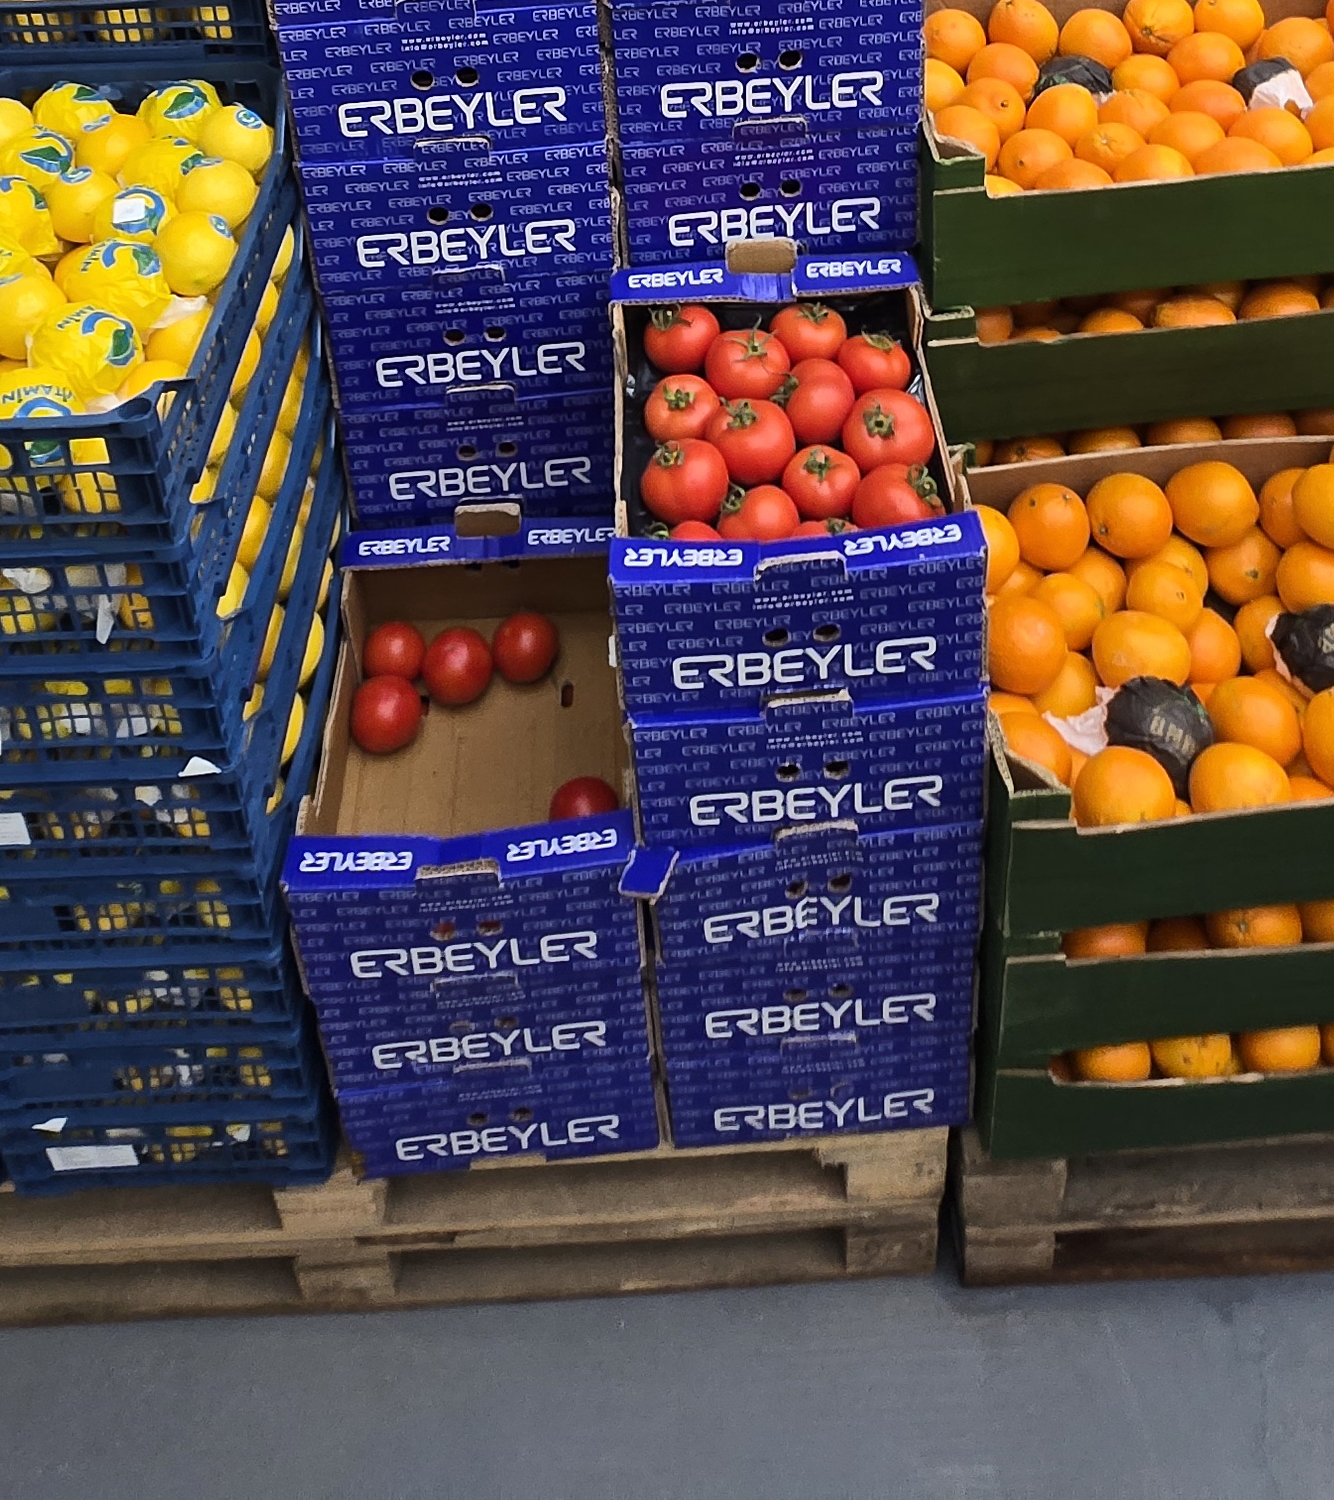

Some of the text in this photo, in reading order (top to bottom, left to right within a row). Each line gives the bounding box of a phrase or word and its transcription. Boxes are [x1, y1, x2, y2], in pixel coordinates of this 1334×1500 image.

[338, 87, 567, 138] ERBEYLER
[661, 71, 884, 119] ERBEYLER
[356, 219, 576, 268] ERBEYLER
[669, 197, 881, 247] ERBEYLER
[628, 259, 901, 288] ERBEYLER ERBEYLER
[376, 342, 586, 388] ERBEYLER
[389, 456, 592, 501] ERBEYLER
[359, 536, 450, 557] ERBEYLER
[624, 524, 962, 567] ERBEYLER ERBEYLER
[673, 637, 937, 689] ERBEYLER
[690, 775, 943, 826] ERBEYLER
[299, 828, 617, 872] ERBEYLER ERBEYLER
[704, 893, 940, 944] ERBEYLER
[350, 931, 598, 979] ERBEYLER
[705, 993, 936, 1039] ERBEYLER
[372, 1020, 607, 1070] ERBEYLER
[715, 1088, 935, 1131] ERBEYLER
[395, 1114, 619, 1161] ERBEYLER
